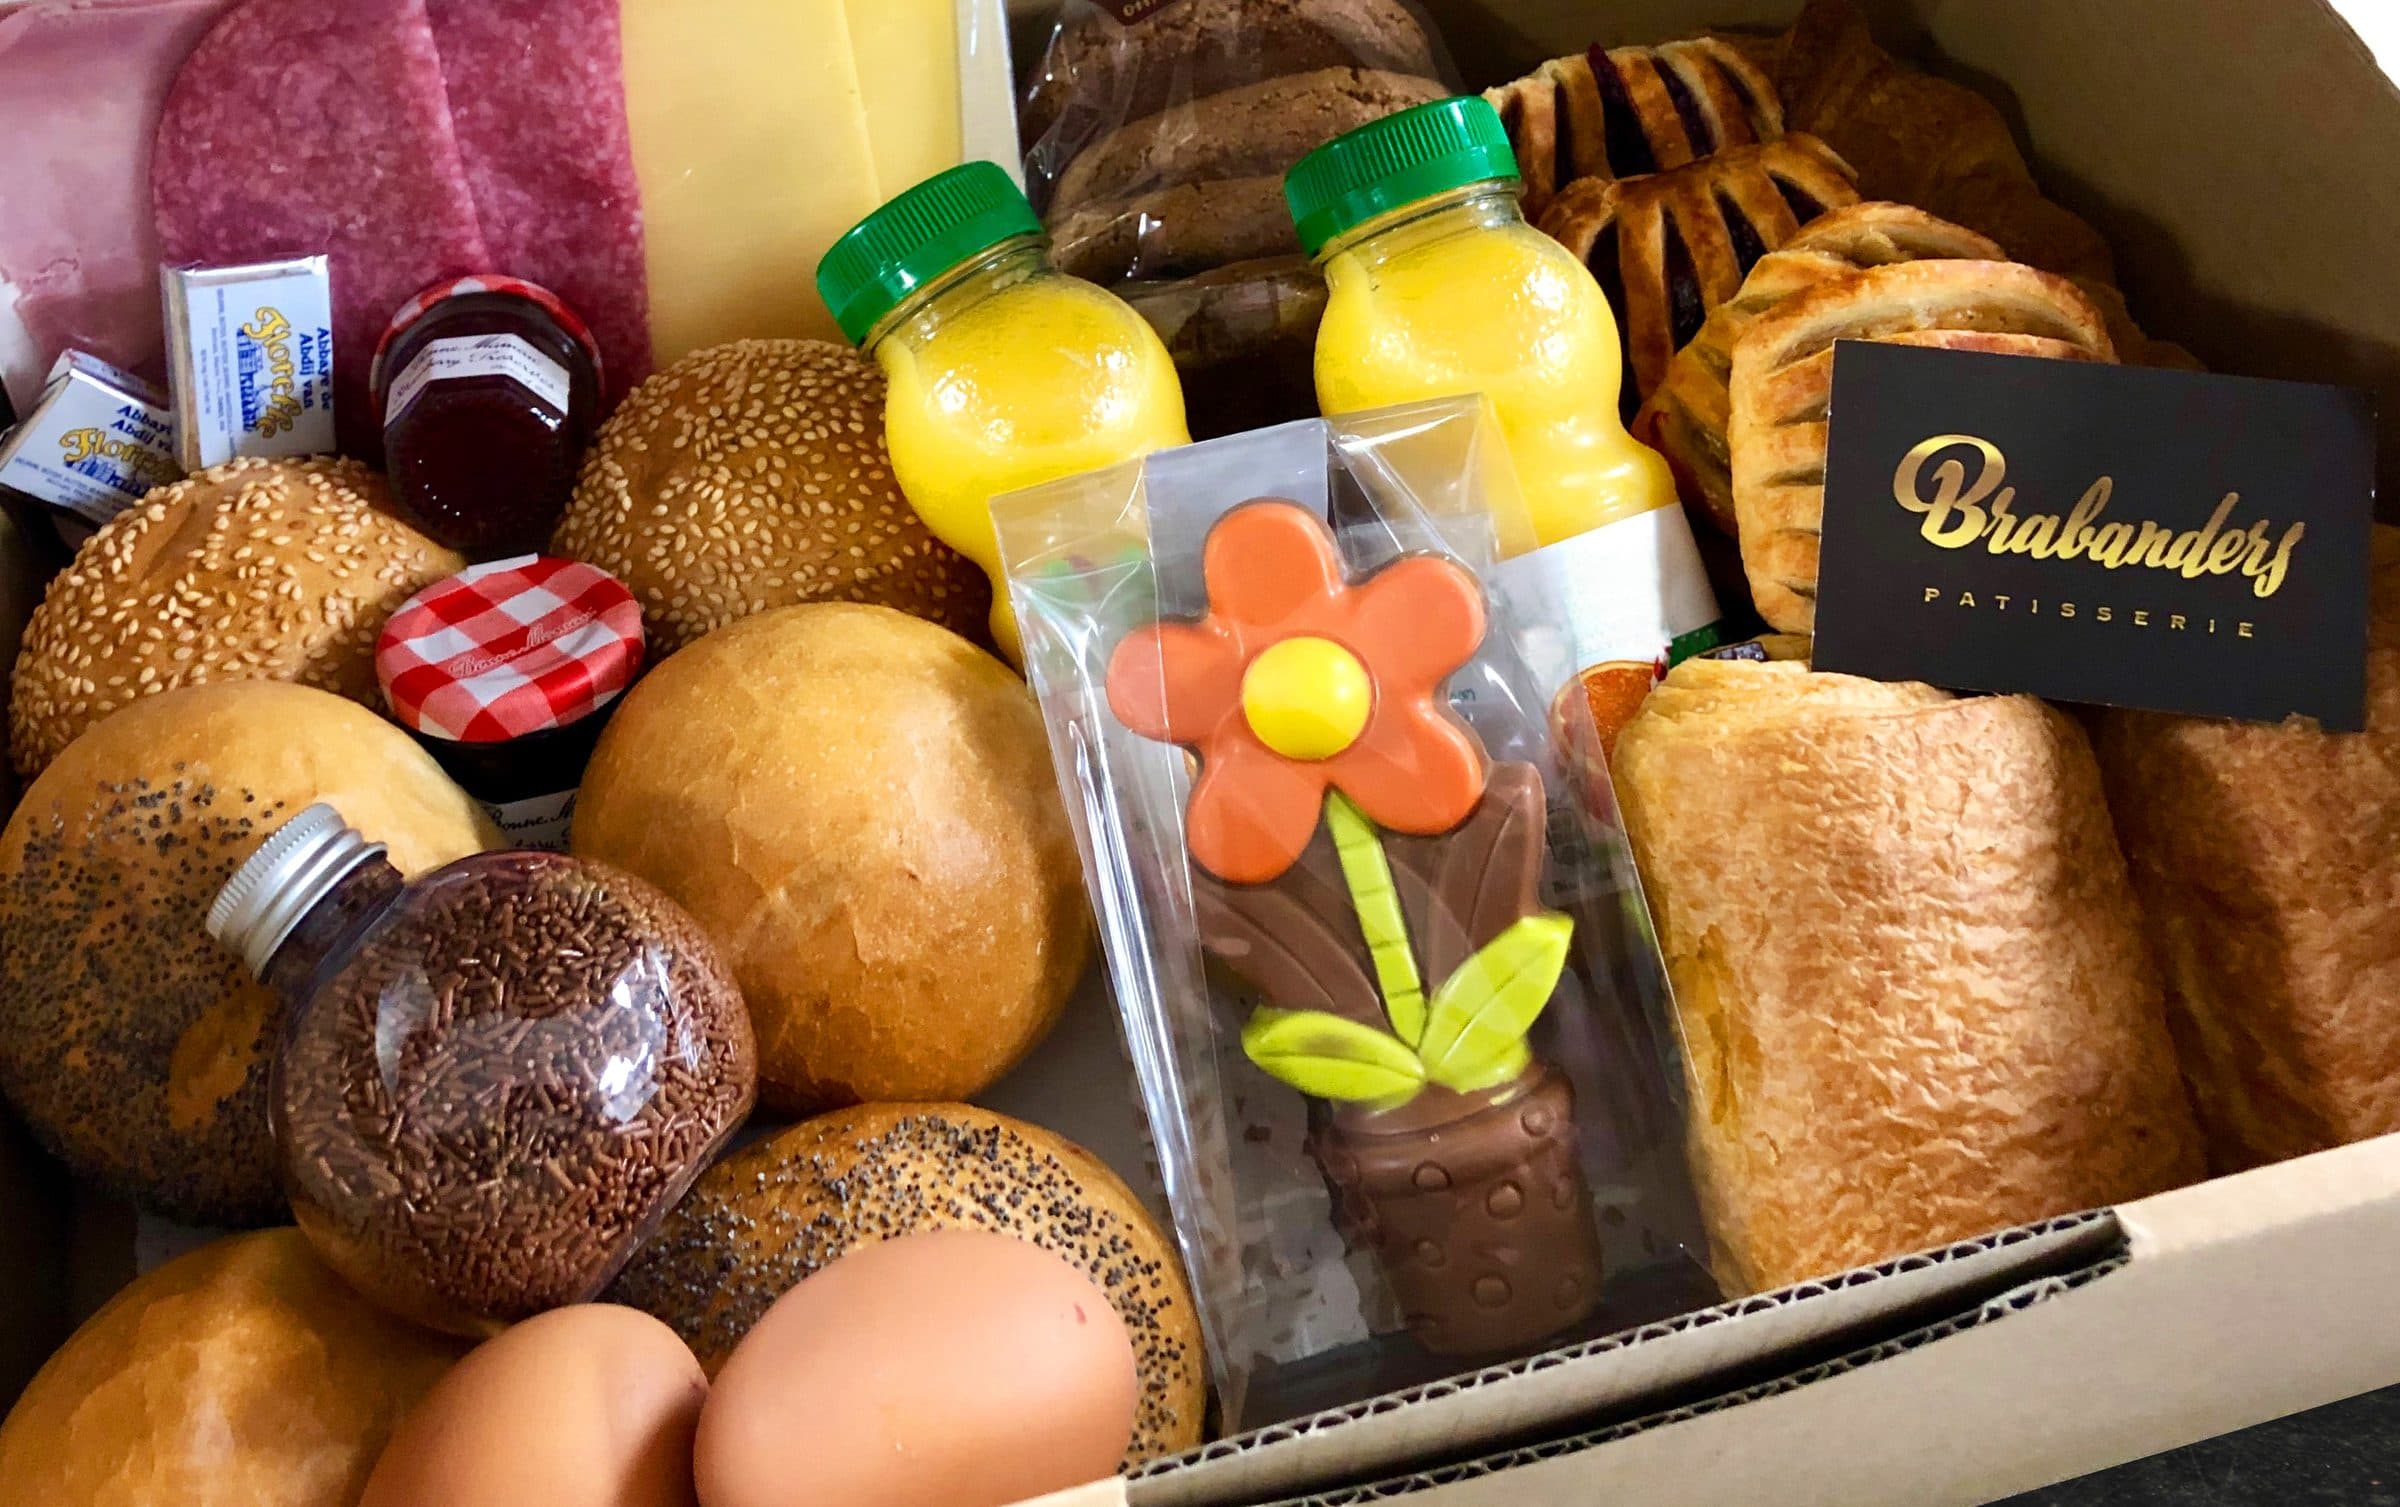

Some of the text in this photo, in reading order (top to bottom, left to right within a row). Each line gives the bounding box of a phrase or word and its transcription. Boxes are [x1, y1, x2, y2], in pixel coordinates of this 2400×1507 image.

[299, 333, 314, 409] Abdij van
[316, 327, 331, 387] Abbaye
[110, 419, 155, 446] Abdij
[1892, 433, 2306, 598] Brabanders
[1924, 587, 2256, 639] PATISSERIE
